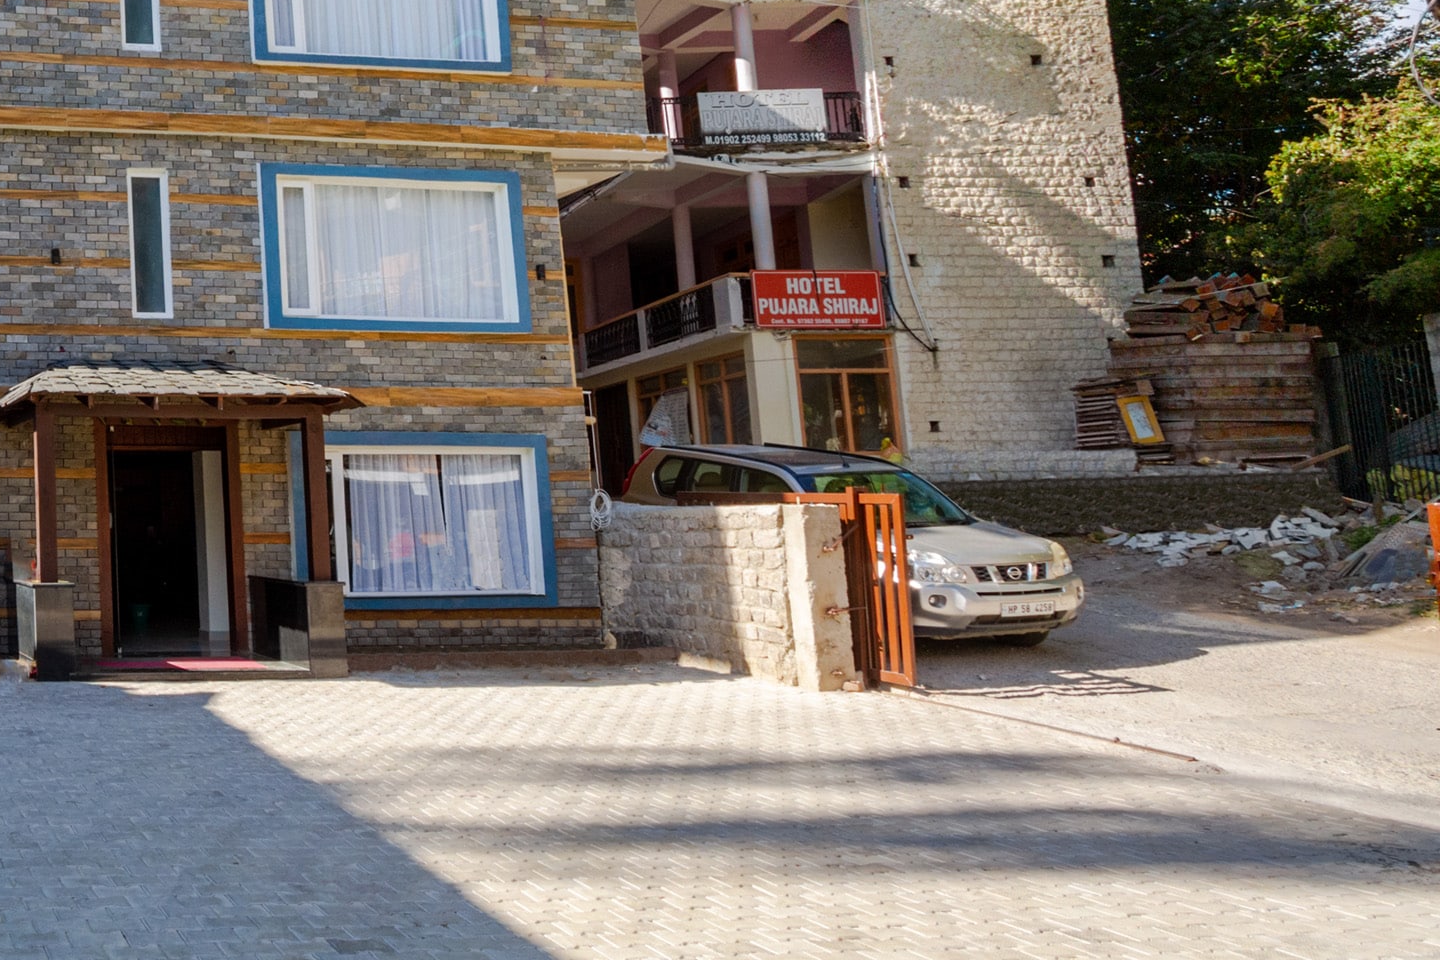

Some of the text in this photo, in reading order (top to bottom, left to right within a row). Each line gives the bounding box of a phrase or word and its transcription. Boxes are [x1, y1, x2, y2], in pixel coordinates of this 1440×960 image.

[710, 92, 809, 108] HOTEL
[702, 107, 823, 134] PUJARA SHIRAJ
[705, 135, 739, 145] M.01902
[741, 134, 771, 144] 252499
[772, 133, 798, 143] 98053
[786, 277, 846, 294] HOTEL
[758, 298, 878, 315] PUJARA SHIRAJ
[1008, 605, 1018, 614] HP
